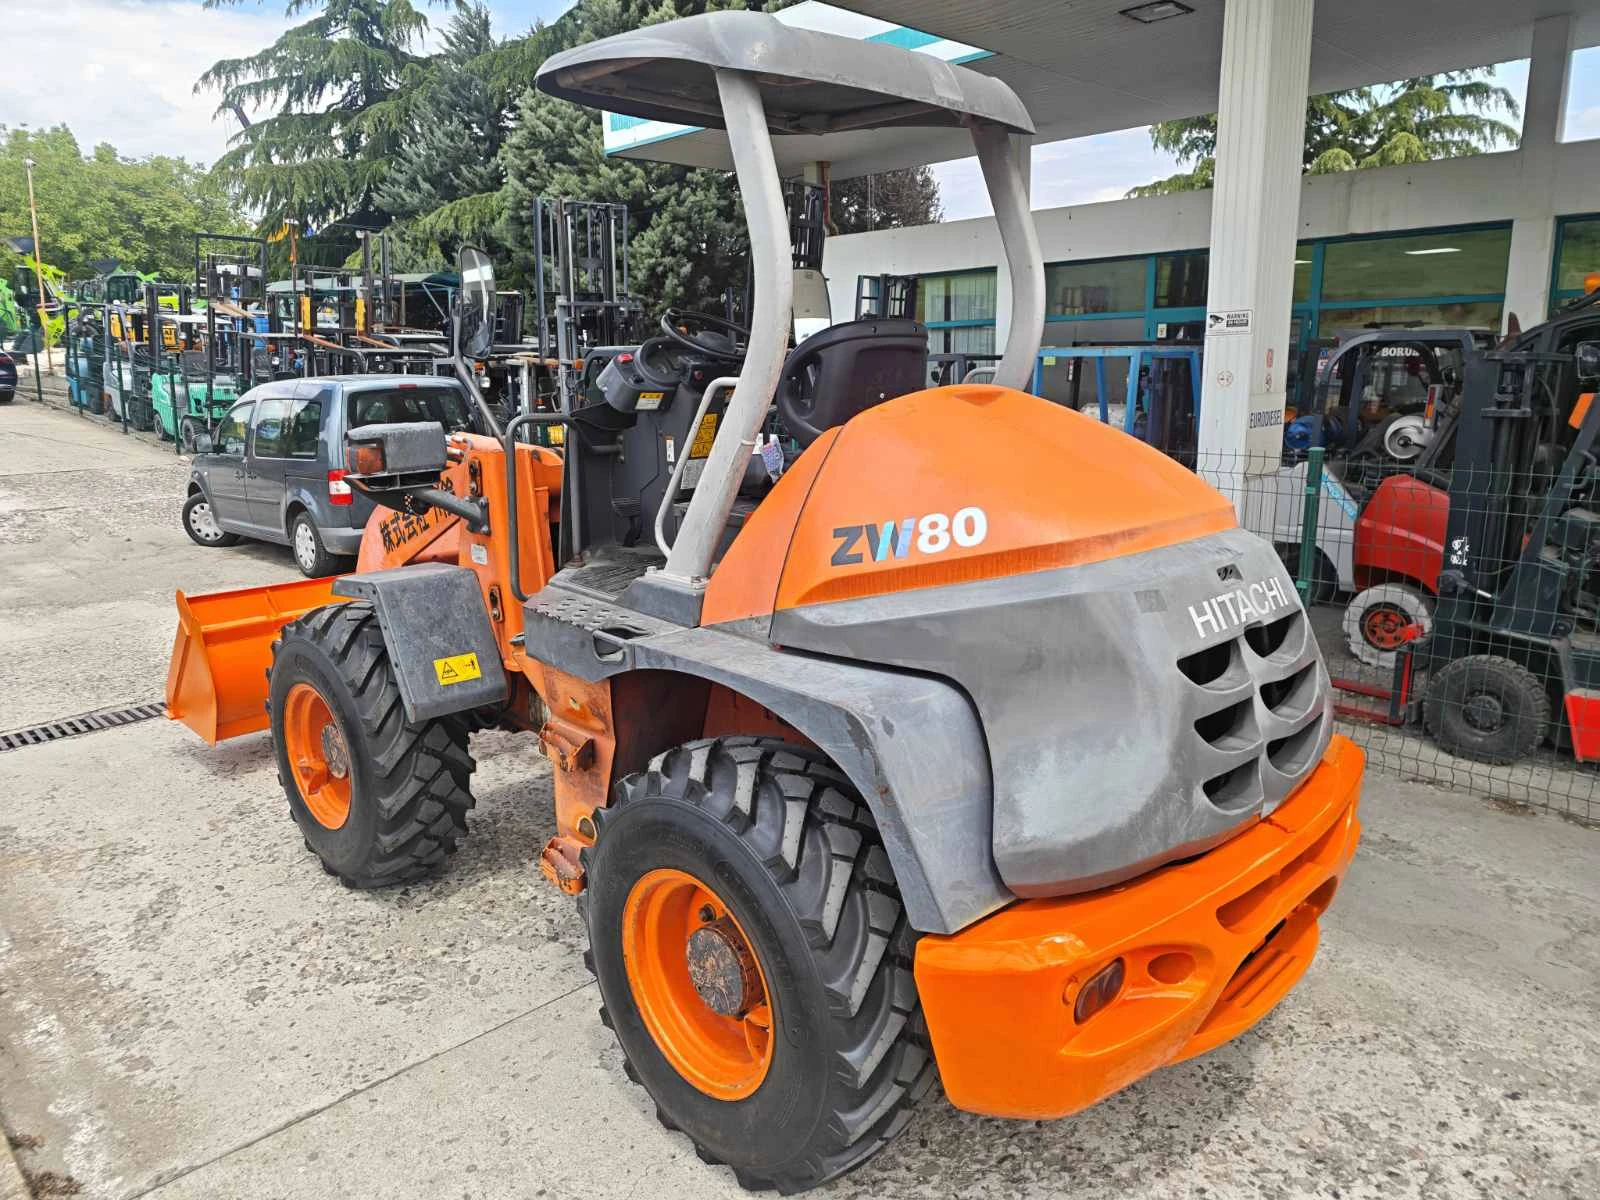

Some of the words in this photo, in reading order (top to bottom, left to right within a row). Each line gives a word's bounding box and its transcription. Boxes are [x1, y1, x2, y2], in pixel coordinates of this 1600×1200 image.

[1249, 410, 1282, 428] EURODIESEL
[831, 506, 988, 566] ZW80
[1187, 576, 1289, 639] HITACHI
